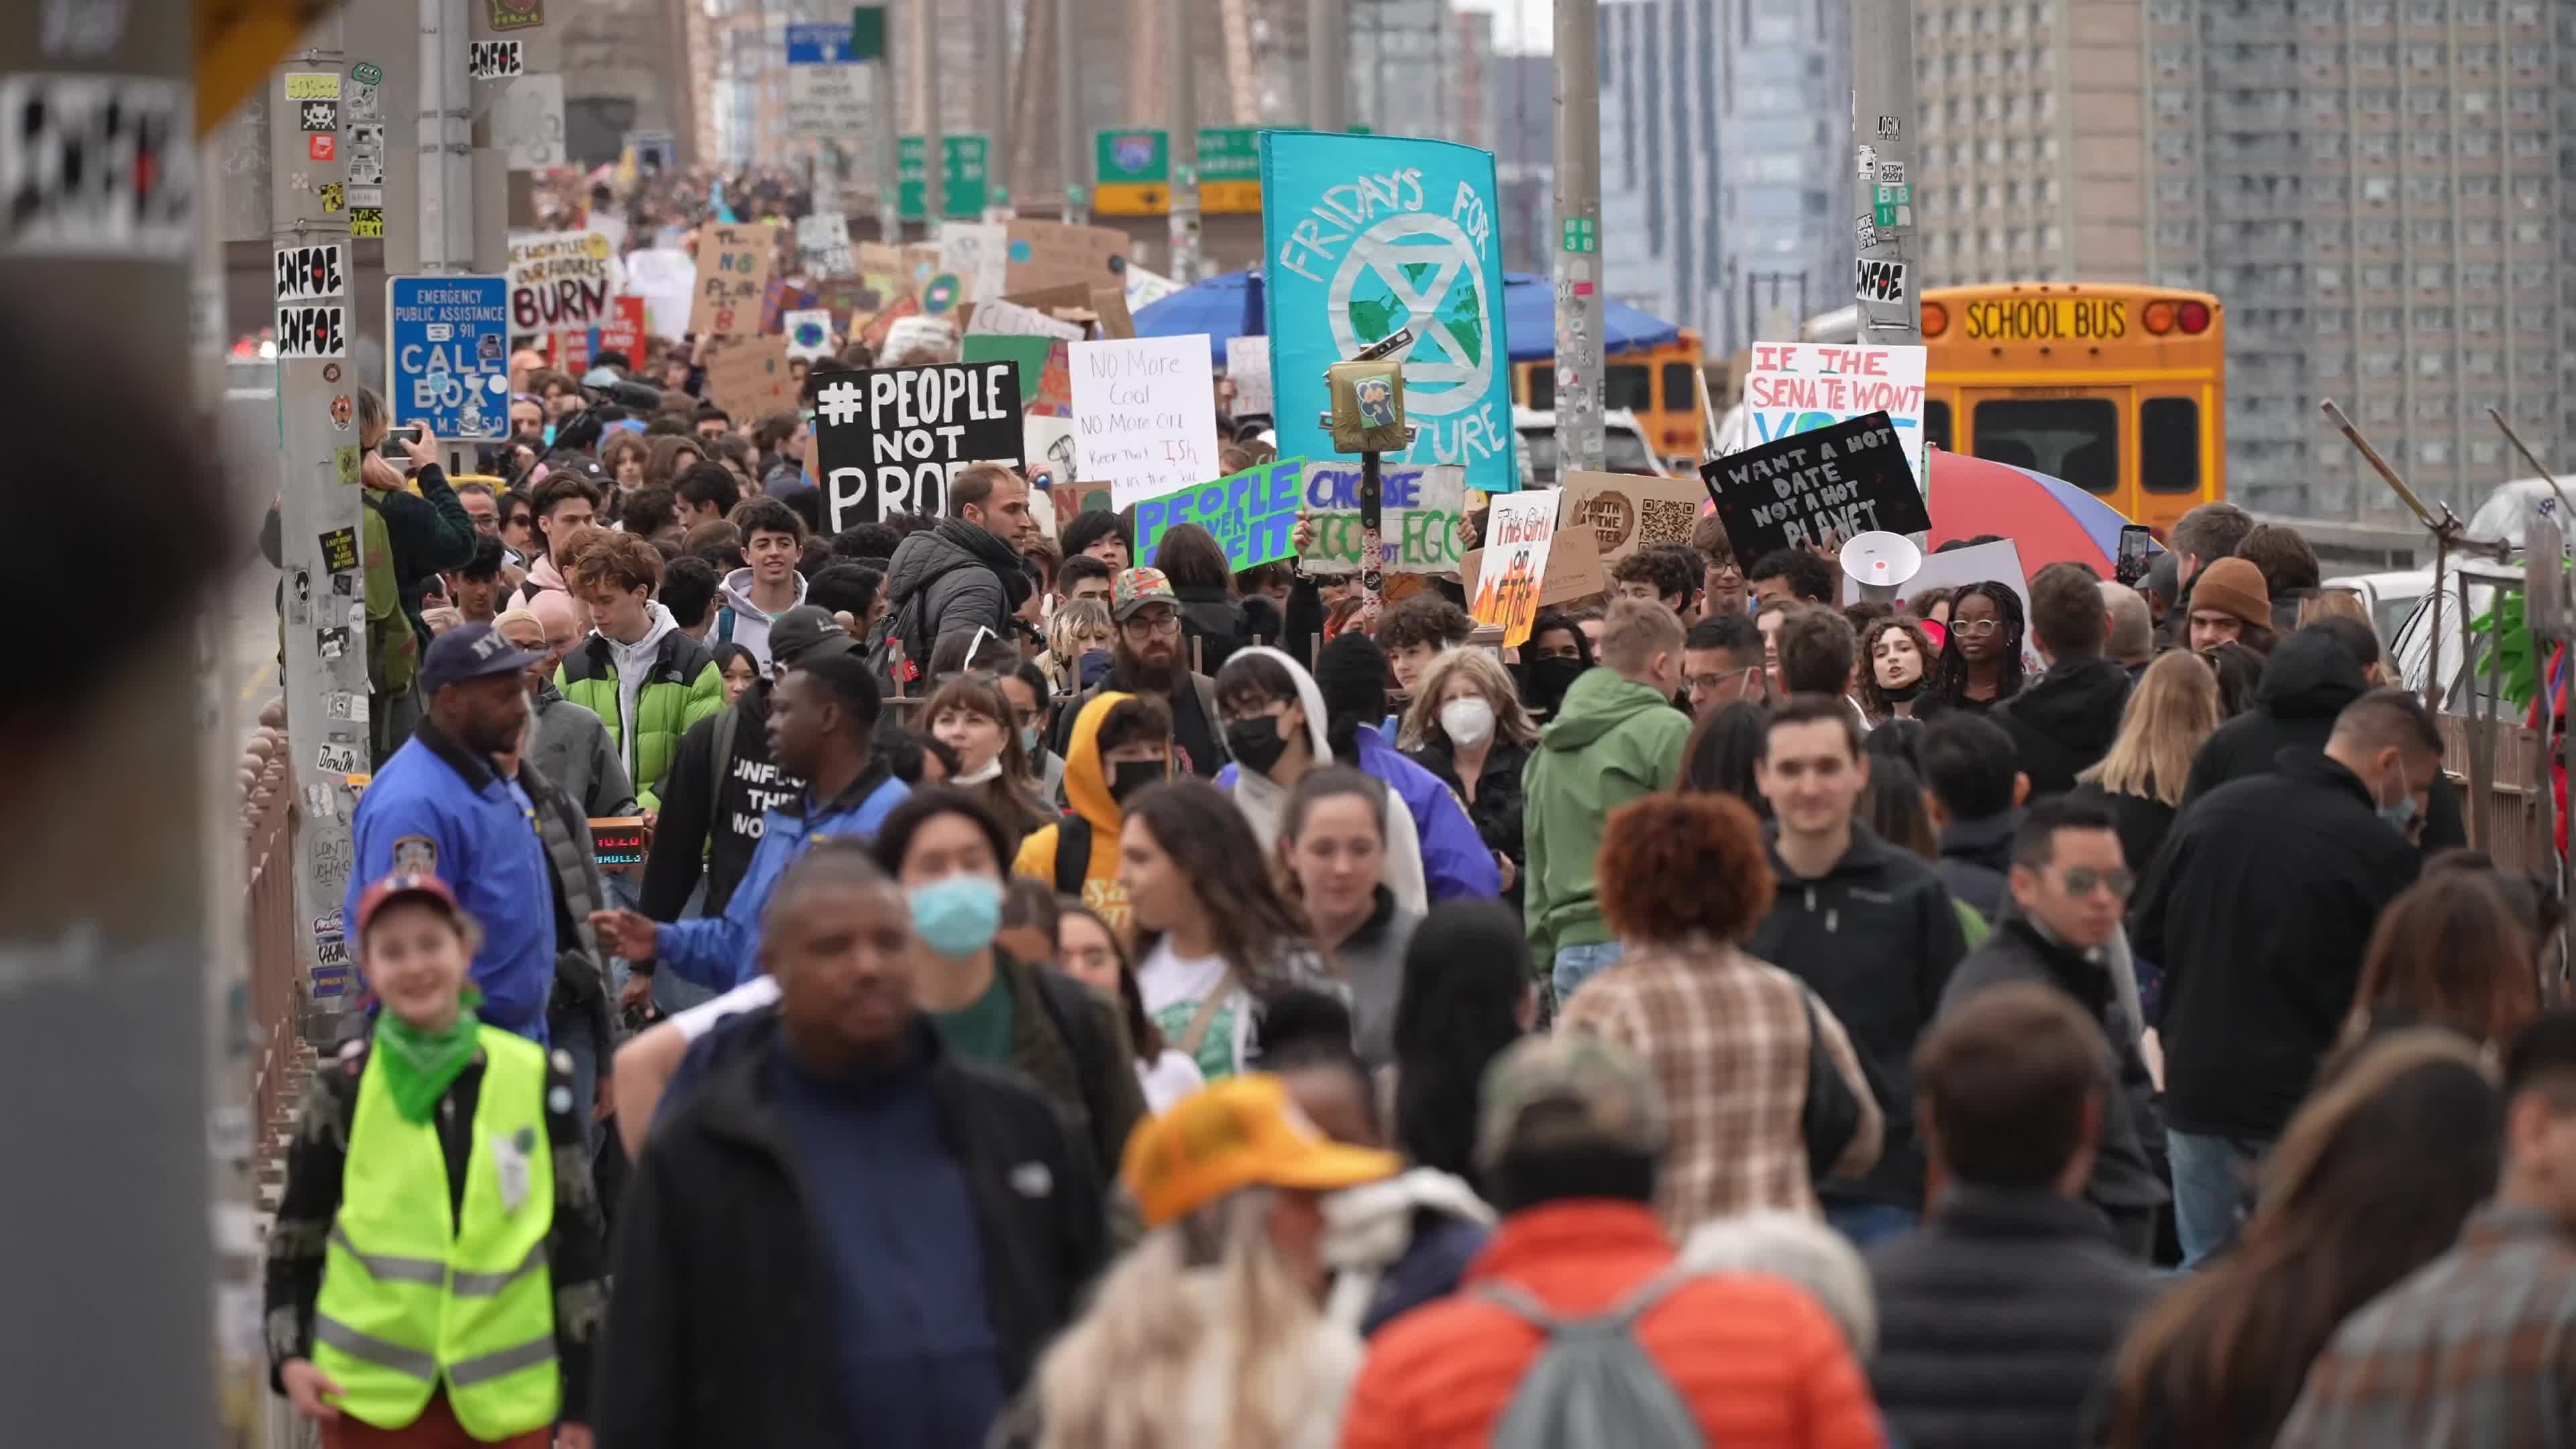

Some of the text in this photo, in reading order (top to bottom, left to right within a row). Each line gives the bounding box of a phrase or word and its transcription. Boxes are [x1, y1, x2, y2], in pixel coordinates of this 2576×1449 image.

[1877, 116, 1900, 134] LOGIK
[1279, 167, 1489, 282] FRIDAYS FOR
[278, 247, 342, 297] INFOE
[1856, 260, 1902, 301] INFOE
[396, 307, 504, 321] PUBLIC ASSISTANCE
[417, 290, 482, 304] EMERGENCY
[514, 279, 609, 328] BURN
[280, 308, 343, 356] INFOE
[460, 323, 476, 338] 911
[1967, 301, 2126, 339] SCHOOL BUS
[401, 344, 501, 373] CALL
[1090, 348, 1181, 378] NO More
[1756, 346, 1888, 376] IF THE
[415, 378, 488, 408] BOX
[1110, 382, 1149, 405] Coal
[1752, 377, 1926, 413] SENATE WONT
[1081, 414, 1102, 435] NO
[1110, 413, 1150, 433] More
[1395, 403, 1505, 466] TURE
[873, 425, 965, 464] NOT
[1710, 476, 1722, 494] I
[1728, 447, 1807, 485] WANT
[1821, 442, 1838, 460] A
[1845, 428, 1890, 453] HOT
[1772, 462, 1841, 498] DATE
[1136, 462, 1301, 547] PEOPLE
[1582, 500, 1620, 514] YOUTH
[1598, 515, 1620, 529] THE
[1752, 480, 1858, 528] NOT A HOT
[1403, 510, 1466, 564] EGO
[1497, 508, 1523, 545] This
[1782, 499, 1881, 552] PLANET
[1381, 543, 1401, 564] OT
[1493, 576, 1535, 629] FIRE
